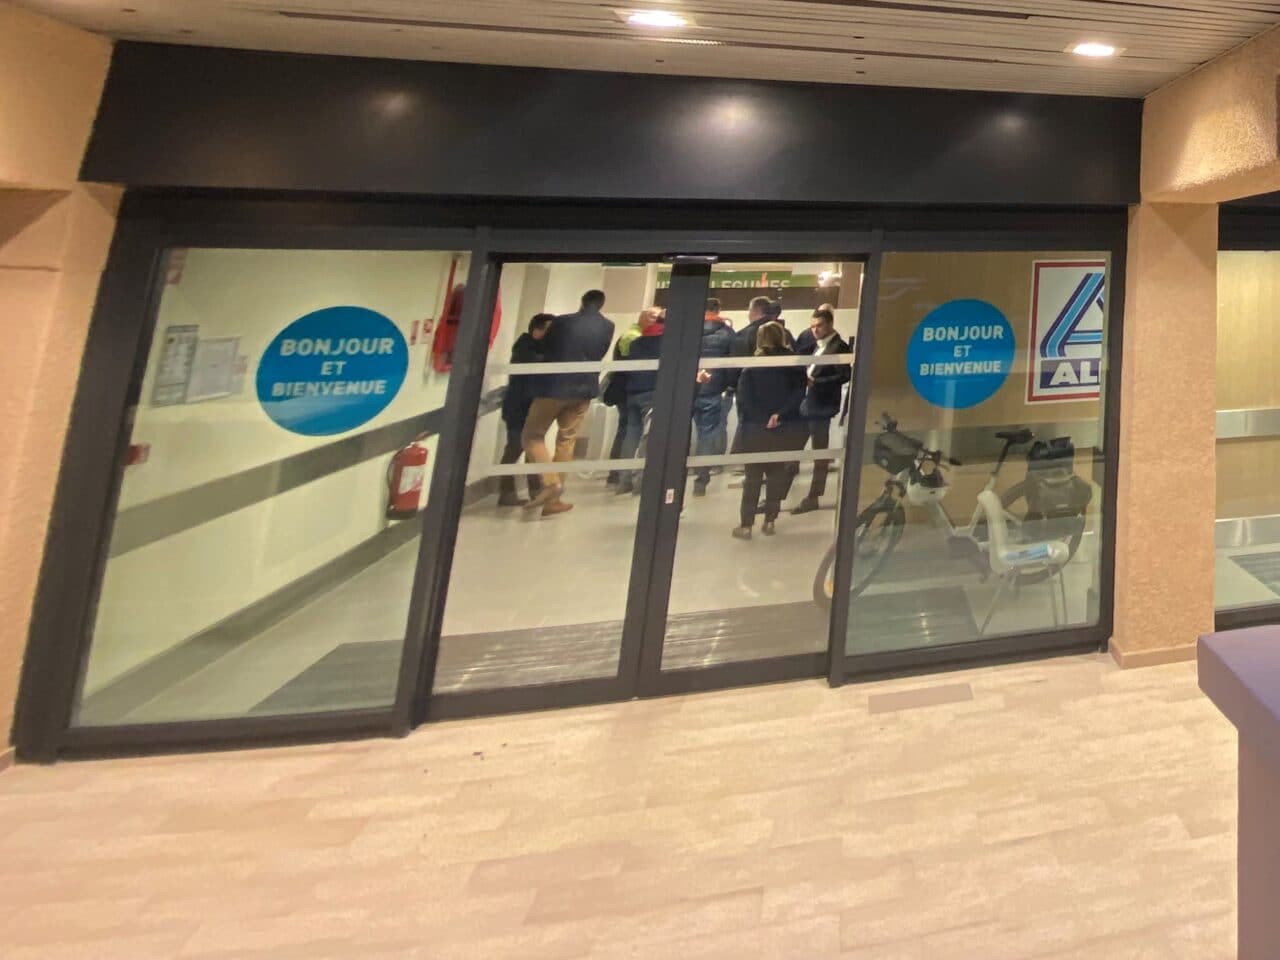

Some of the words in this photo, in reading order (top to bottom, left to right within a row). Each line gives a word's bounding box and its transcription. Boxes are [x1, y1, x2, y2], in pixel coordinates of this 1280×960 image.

[923, 325, 1004, 342] BONJOUR
[279, 338, 394, 357] BONJOUR
[953, 345, 972, 358] ET
[320, 360, 347, 376] ET
[919, 360, 1001, 376] BIENVENUE
[1050, 360, 1101, 386] AL
[271, 379, 387, 398] BIENVENUE
